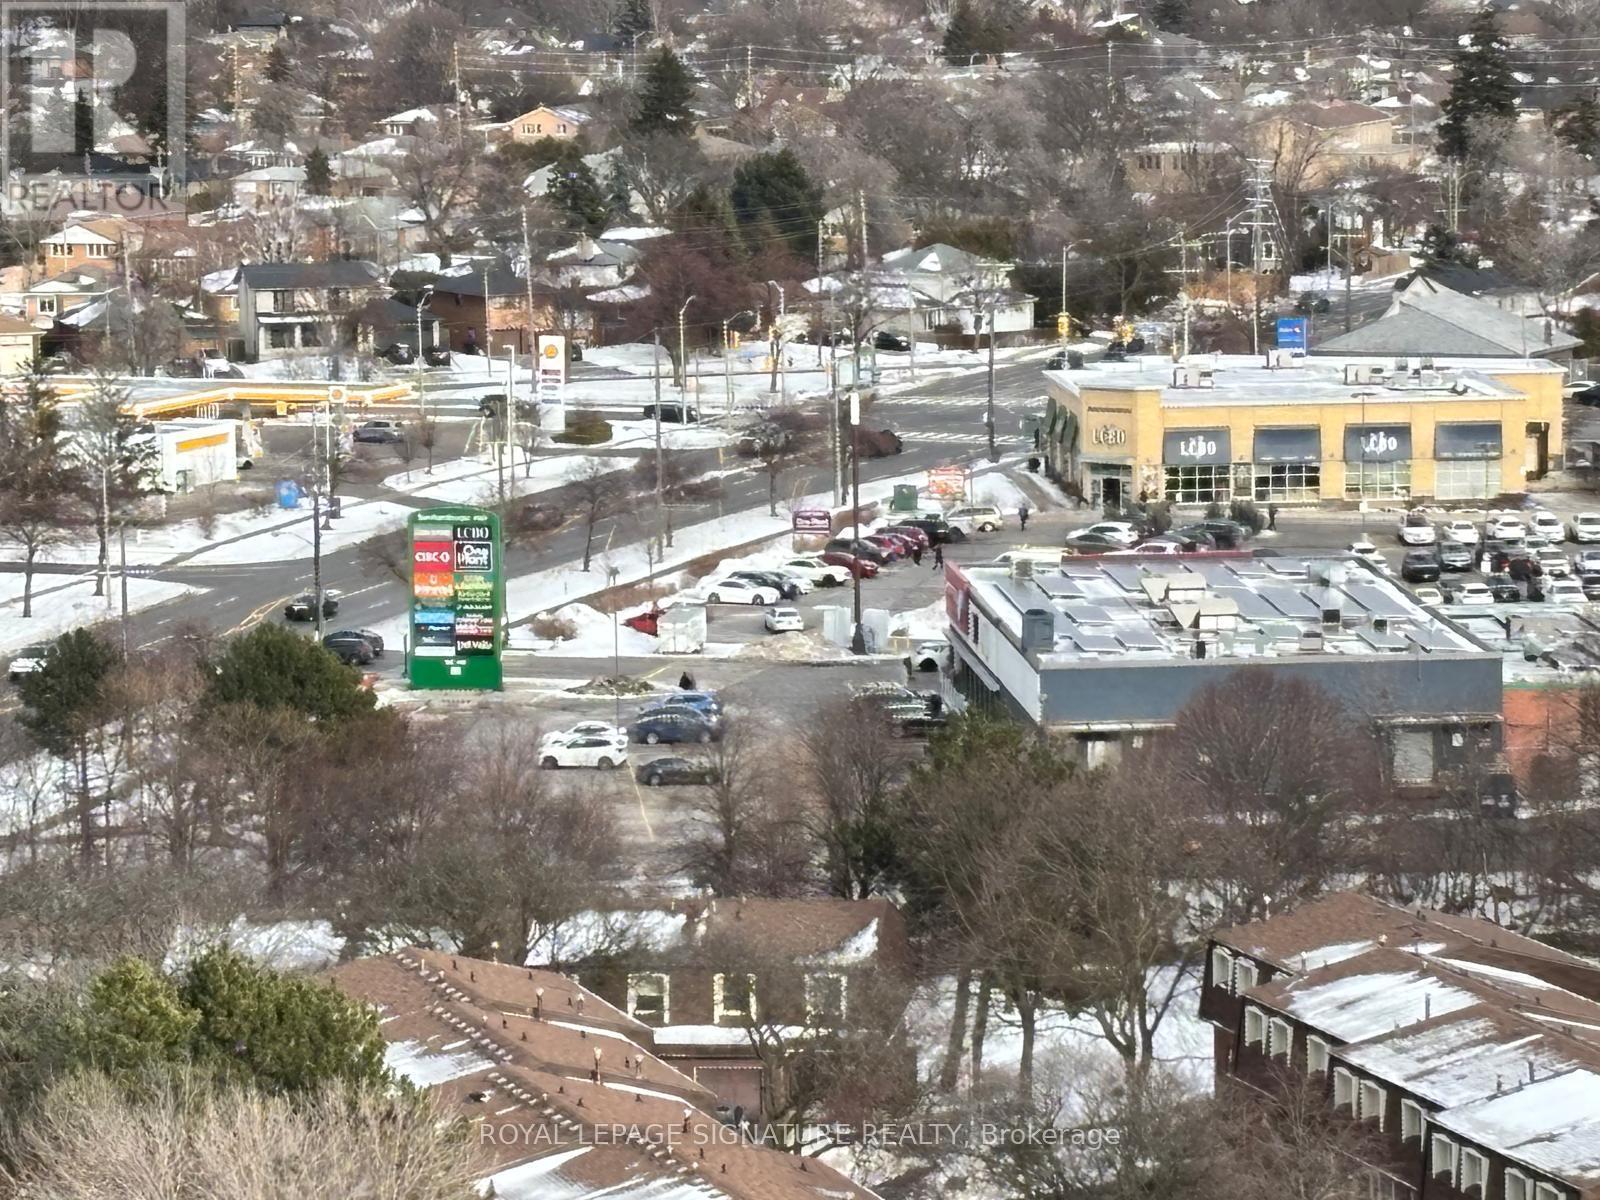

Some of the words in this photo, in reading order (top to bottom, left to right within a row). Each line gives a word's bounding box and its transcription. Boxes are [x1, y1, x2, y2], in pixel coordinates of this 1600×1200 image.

[1092, 427, 1126, 446] LCBO
[1180, 438, 1217, 457] LCBO
[457, 527, 489, 539] LCBO
[415, 551, 439, 562] CIBC
